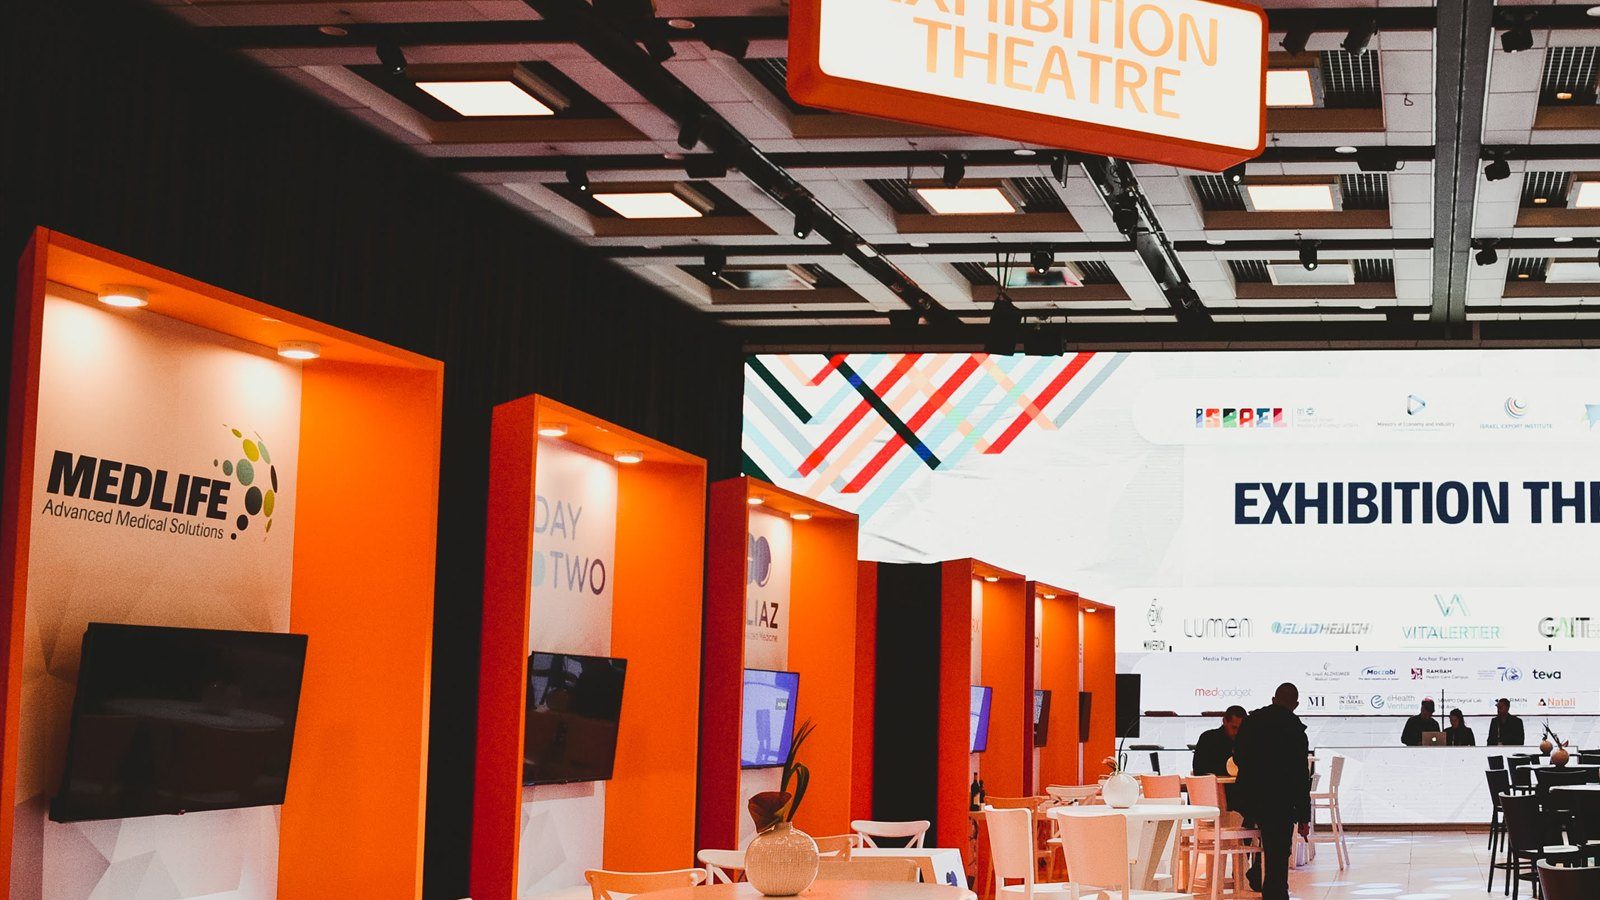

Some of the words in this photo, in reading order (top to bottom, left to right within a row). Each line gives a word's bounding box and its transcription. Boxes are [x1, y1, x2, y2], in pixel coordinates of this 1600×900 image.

[912, 16, 1182, 119] THEATRE
[1195, 408, 1288, 428] ISRAEL
[46, 450, 231, 521] MEDLIFE
[1234, 480, 1509, 525] EXHIBITION
[42, 498, 112, 524] Advanced
[115, 511, 167, 532] Medical
[169, 518, 224, 540] Solutions
[534, 494, 582, 541] DAY
[550, 550, 606, 596] TWO
[1402, 625, 1501, 640] VITALERTER
[1532, 668, 1562, 680] teva
[1547, 697, 1576, 707] Natali
